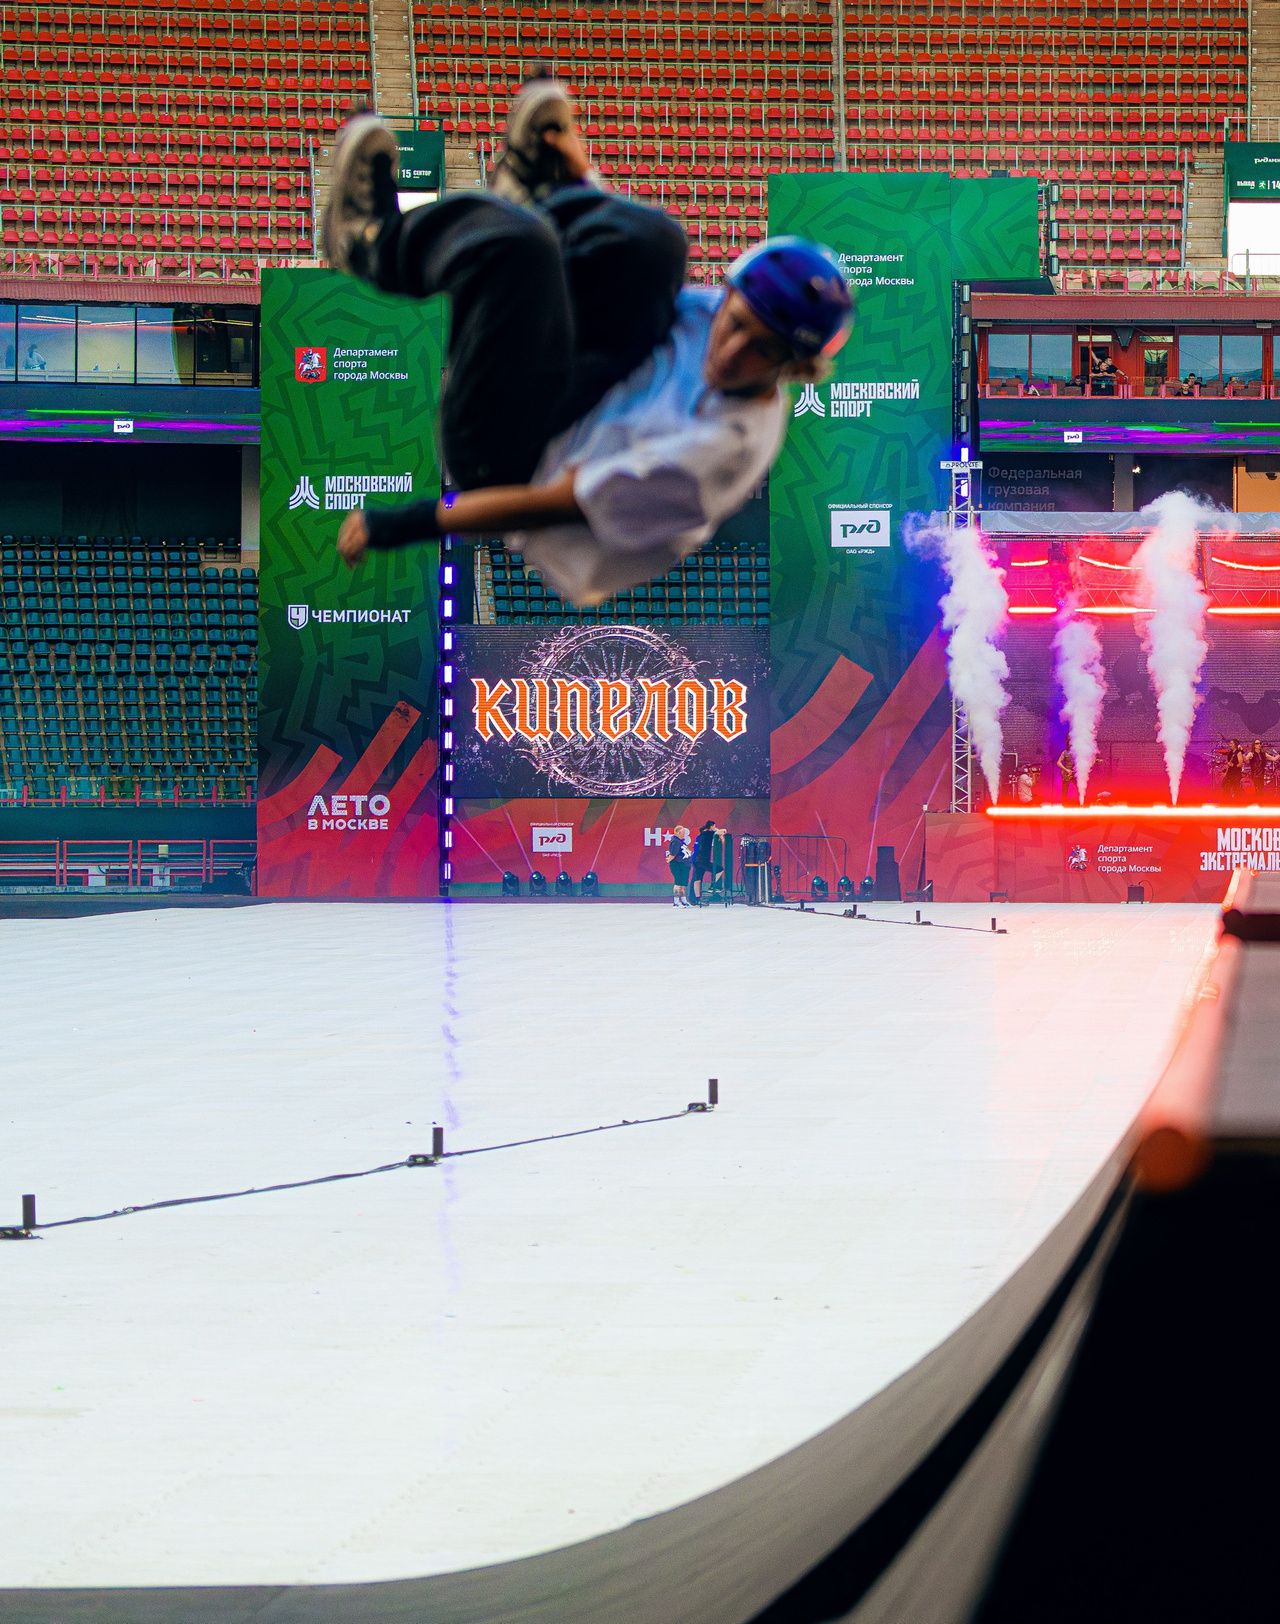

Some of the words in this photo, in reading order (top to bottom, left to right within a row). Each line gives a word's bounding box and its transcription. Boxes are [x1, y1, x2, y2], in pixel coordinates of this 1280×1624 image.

[401, 169, 411, 178] 15
[1272, 181, 1280, 189] 14
[838, 253, 904, 263] Департамент
[876, 277, 914, 285] Москвы
[333, 347, 398, 357] Департамент
[333, 361, 367, 369] спорта
[333, 372, 367, 381] города
[370, 371, 408, 380] Москвы
[830, 379, 919, 399] МОСКОВСКИЙ
[830, 401, 872, 417] СПОРТ
[988, 465, 1082, 482] Федеральная
[325, 472, 413, 493] МОСКОВСКИЙ
[988, 486, 1049, 498] грузовая
[325, 494, 366, 510] СПОРТ
[988, 501, 1055, 511] компания
[311, 609, 411, 623] ЧЕМПИОНАТ
[307, 794, 390, 816] ЛЕТО
[308, 819, 318, 830] В
[322, 819, 389, 830] МОСКВЕ
[1097, 845, 1153, 853] Департамент
